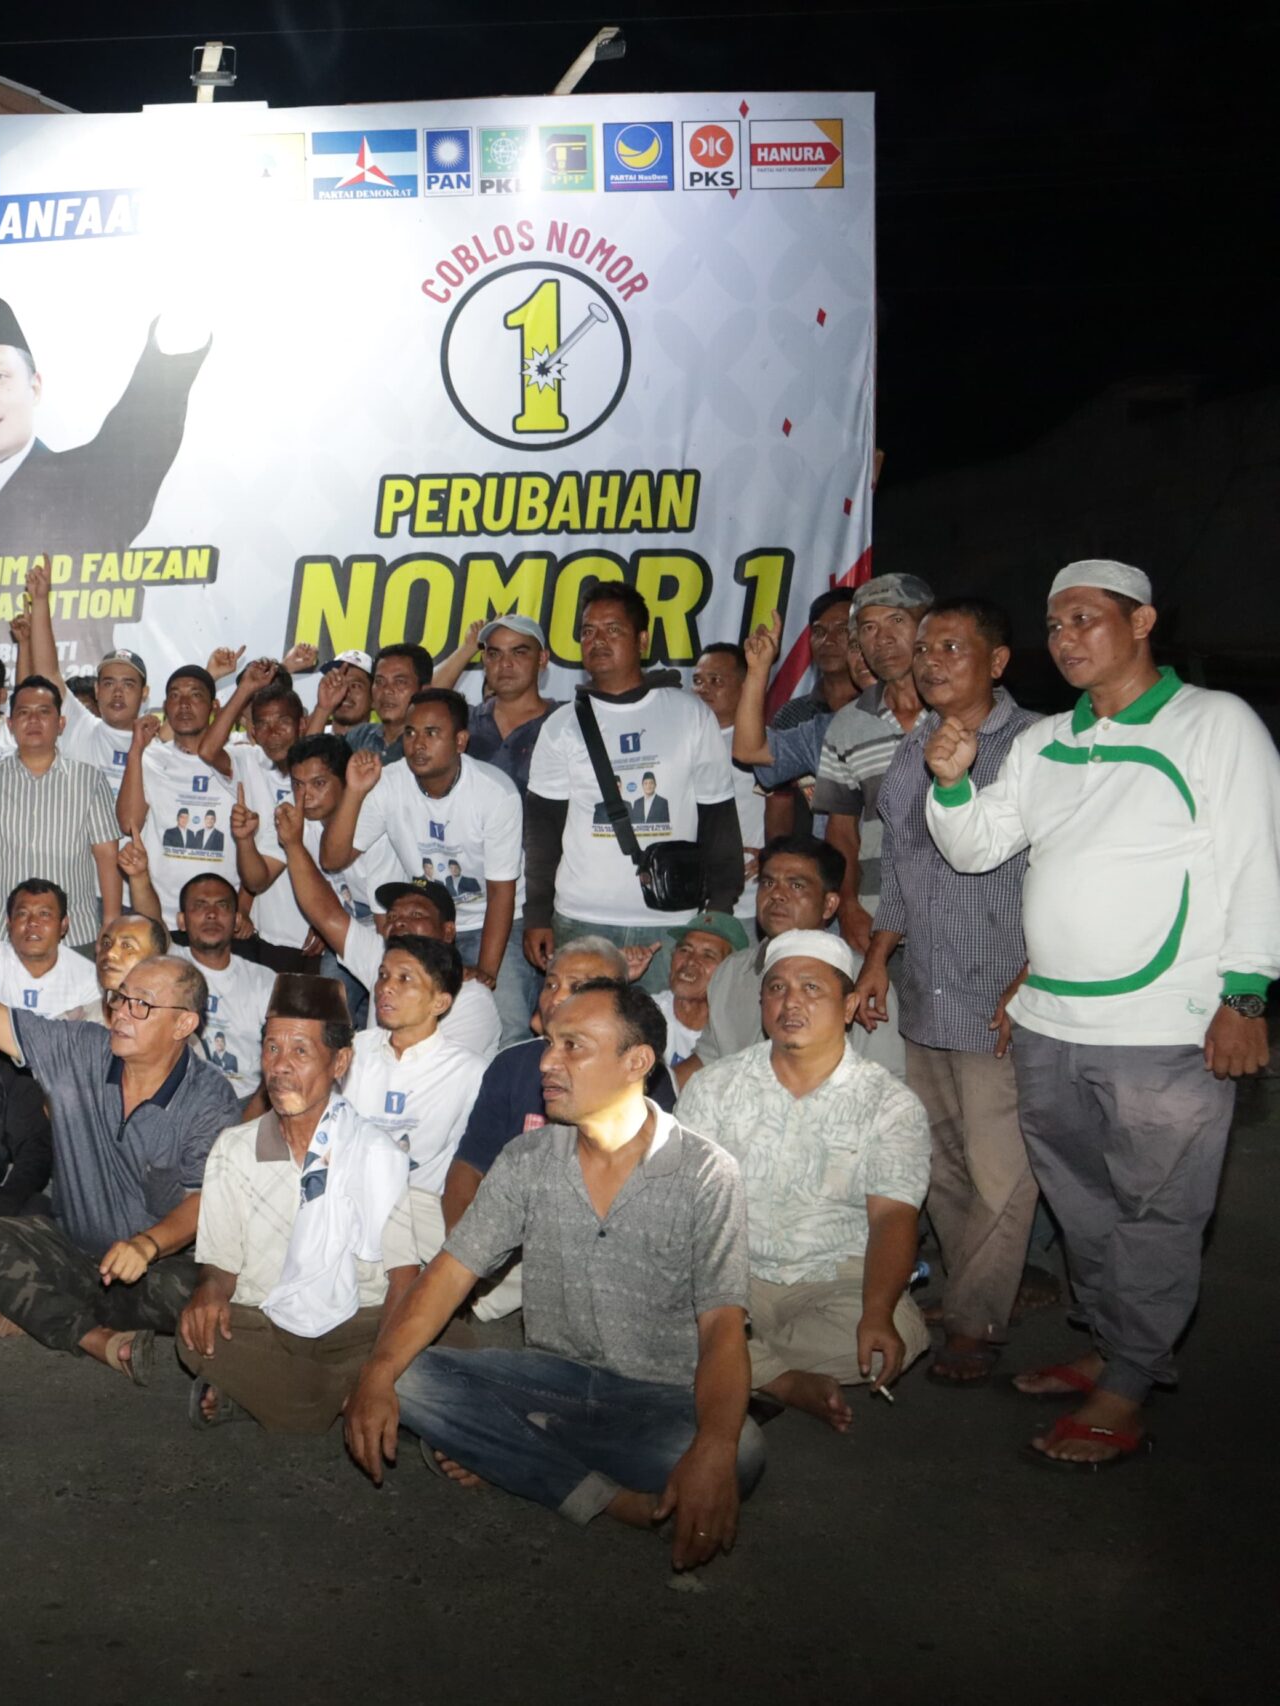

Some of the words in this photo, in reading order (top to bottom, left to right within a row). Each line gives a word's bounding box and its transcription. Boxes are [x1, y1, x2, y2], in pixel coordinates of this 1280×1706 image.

[756, 146, 826, 162] HANURA
[427, 174, 471, 190] PAN
[551, 175, 585, 184] PPP
[689, 171, 735, 187] PKS
[318, 190, 354, 199] PARTAI
[356, 188, 412, 198] DEMOKRAT
[421, 219, 535, 304] COBLOS
[546, 220, 649, 302] NOMOR
[504, 278, 569, 434] 1
[377, 472, 698, 536] PERUBAHAN
[79, 548, 211, 583] FAUZAN
[737, 550, 793, 650] 1
